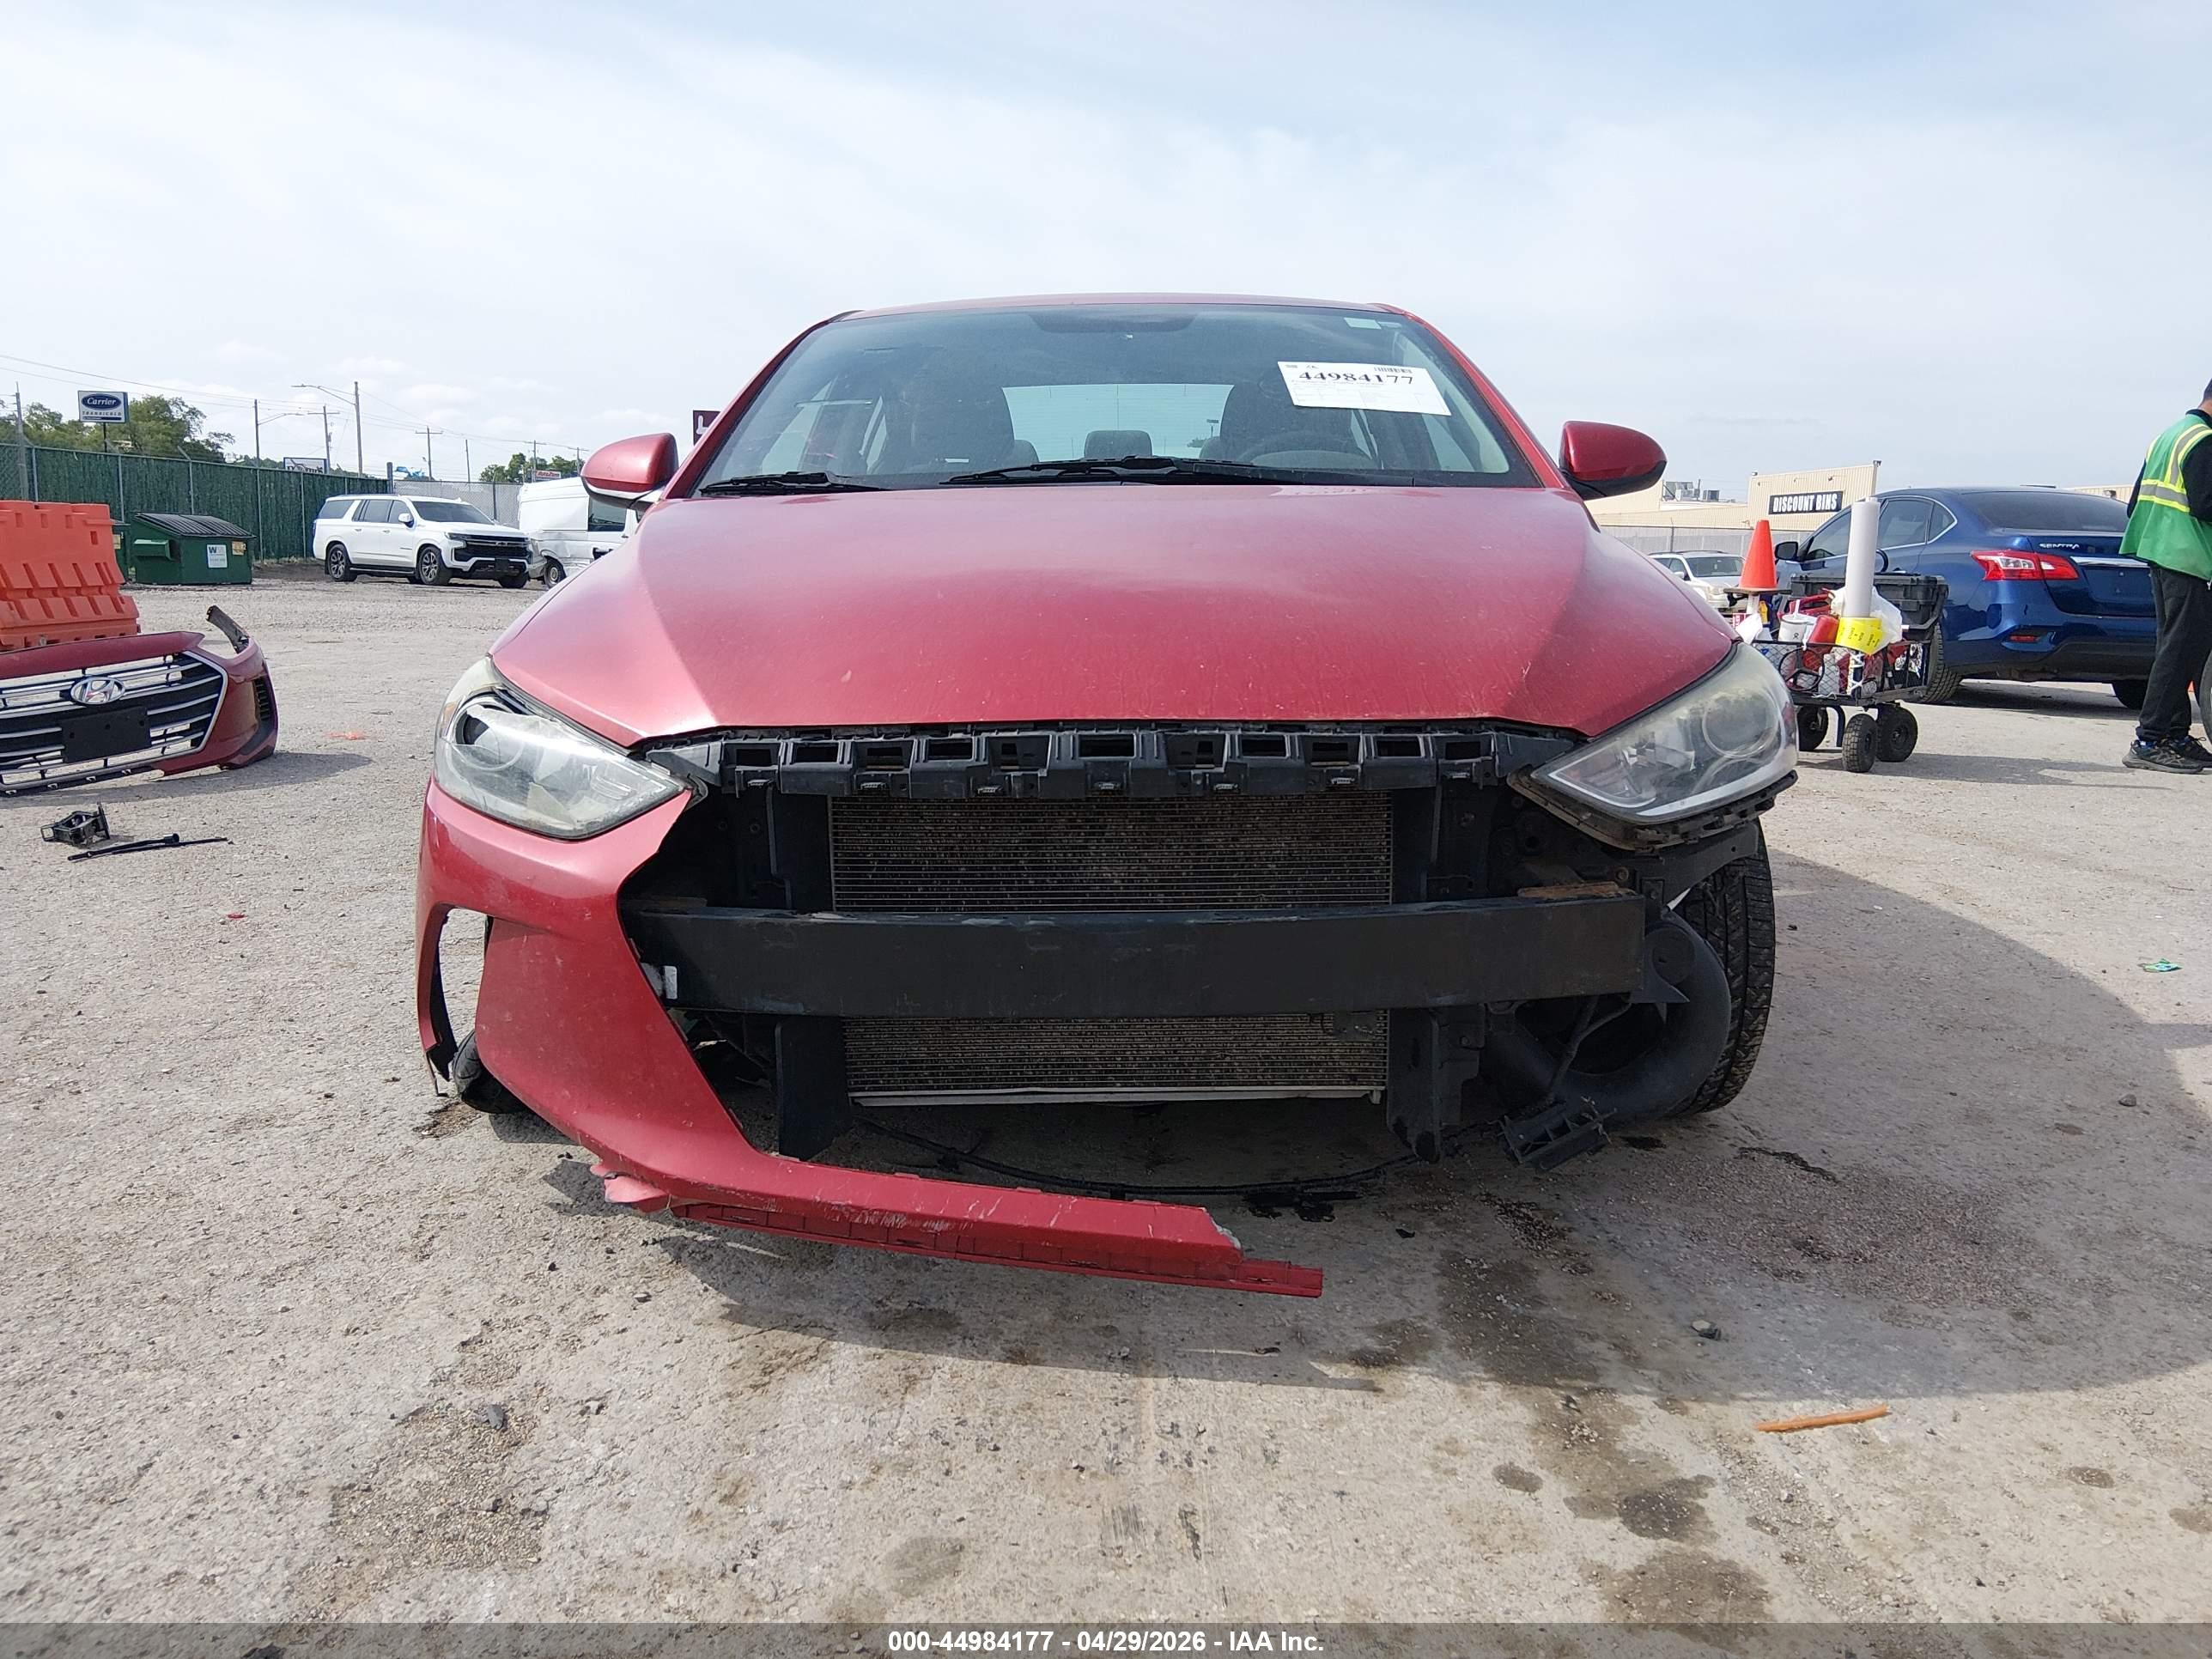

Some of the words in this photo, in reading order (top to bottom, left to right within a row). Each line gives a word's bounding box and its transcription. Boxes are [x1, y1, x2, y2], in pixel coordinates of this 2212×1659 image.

[1298, 371, 1413, 385] 44984177
[87, 397, 117, 405] Carrier
[1772, 495, 1814, 513] DISCOUNT
[1815, 493, 1838, 511] BINS
